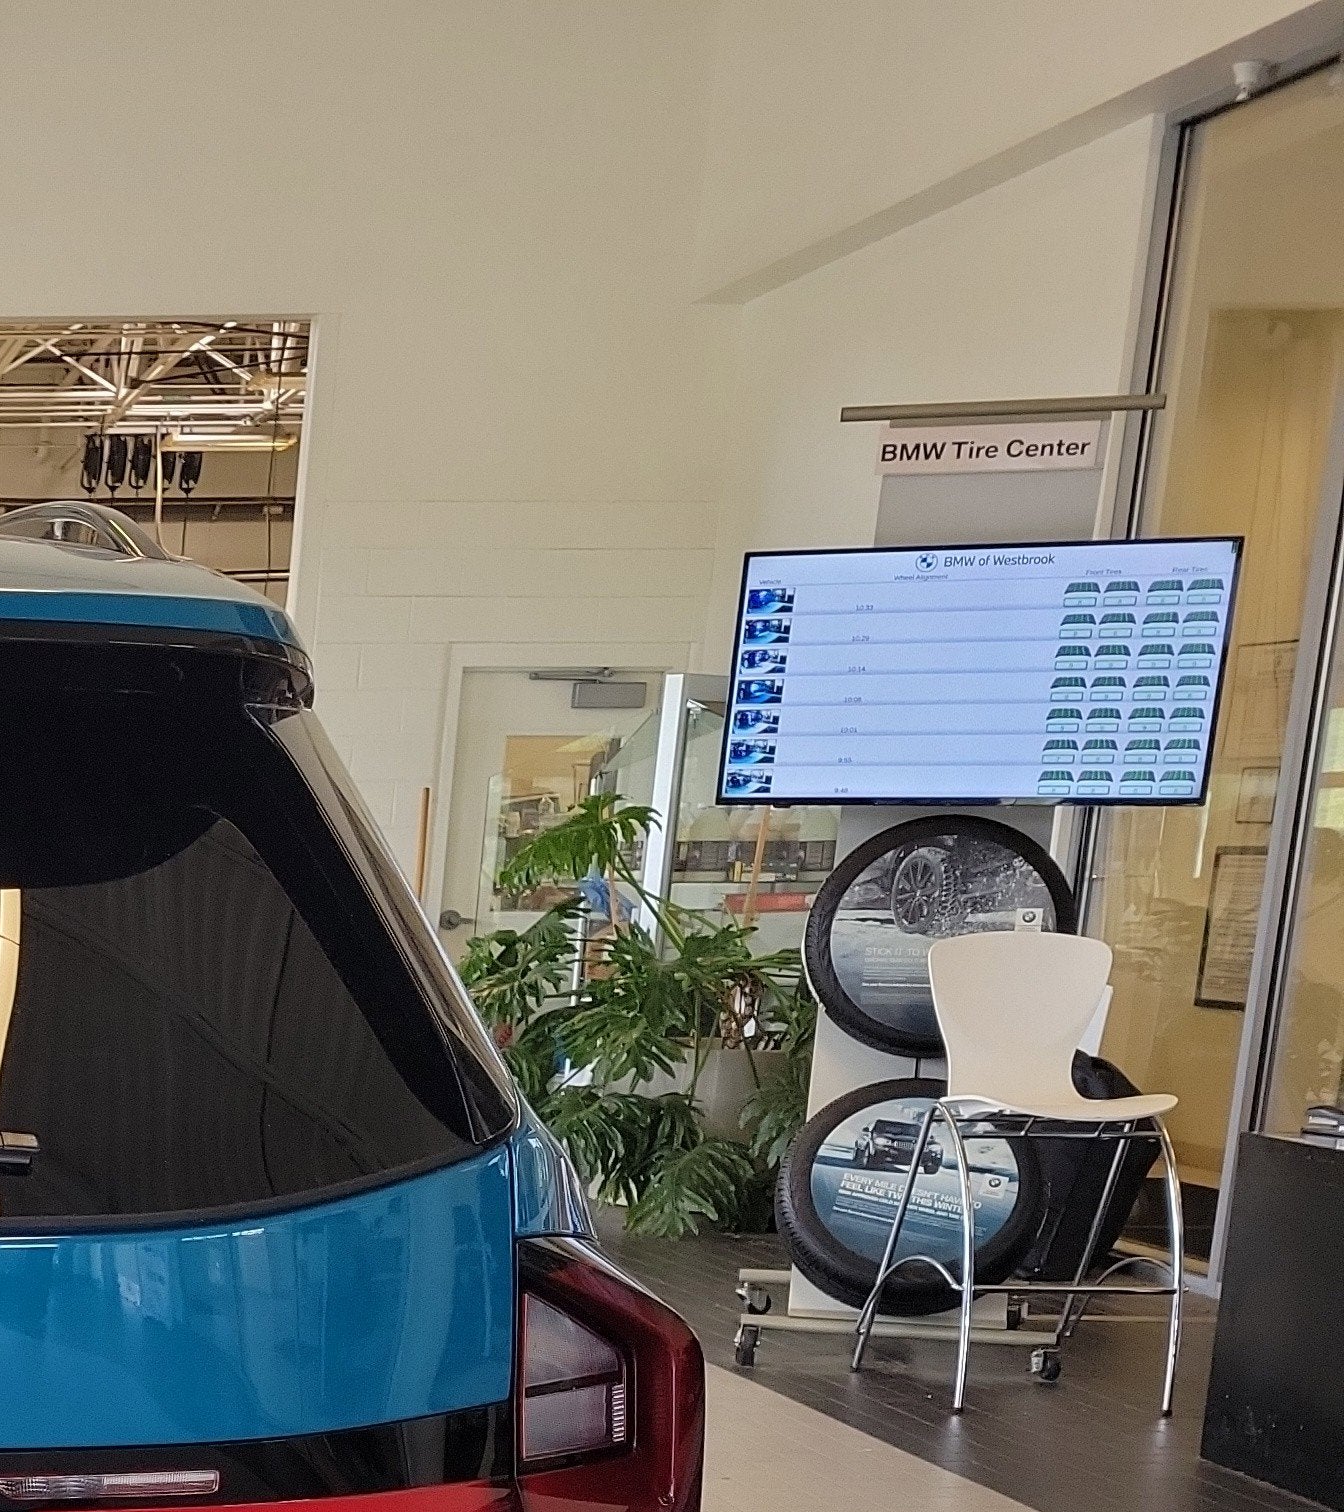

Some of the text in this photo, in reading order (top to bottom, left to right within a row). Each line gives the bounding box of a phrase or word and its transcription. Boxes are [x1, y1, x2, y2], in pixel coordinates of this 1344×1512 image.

[881, 439, 1091, 462] BMW Tire Center
[944, 556, 976, 567] BMW
[978, 555, 991, 566] of
[993, 554, 1056, 566] Westbrook
[840, 1179, 864, 1192] FEEL
[864, 1185, 886, 1197] LIKE
[911, 1195, 933, 1206] THIS
[844, 1172, 873, 1185] EVERY
[940, 1194, 963, 1206] HAV
